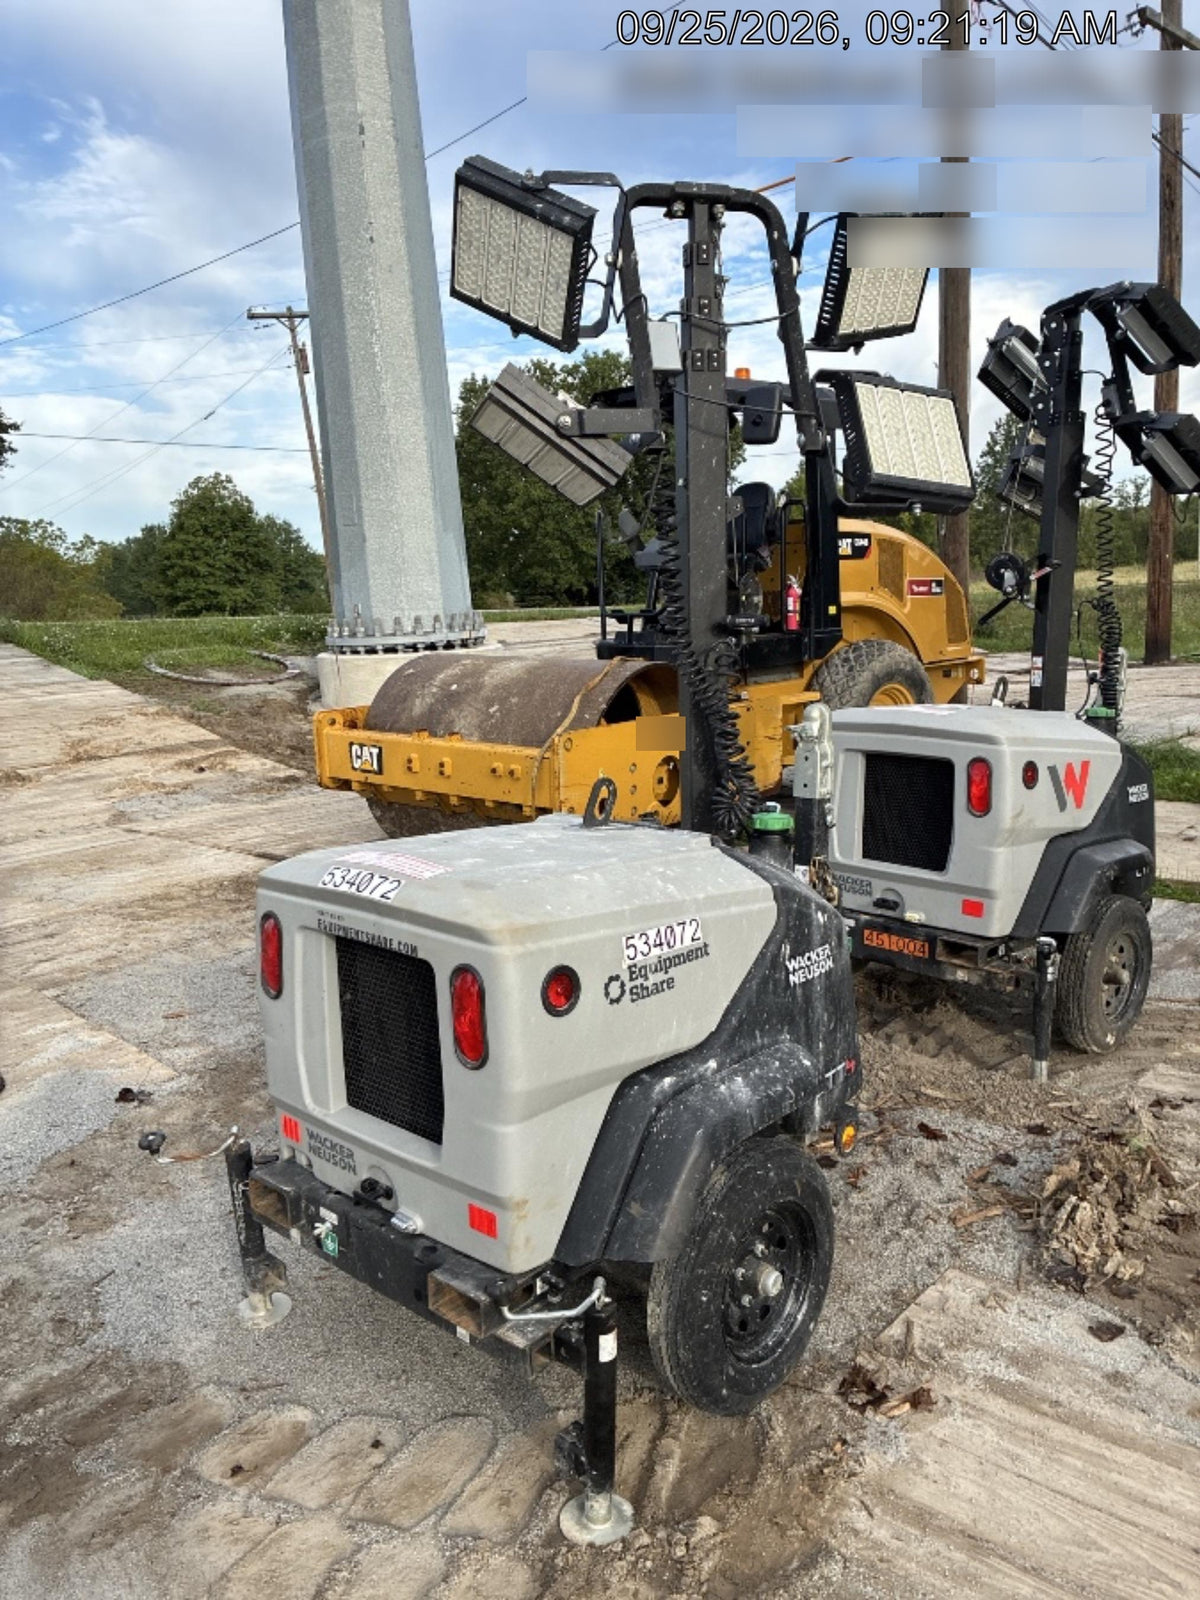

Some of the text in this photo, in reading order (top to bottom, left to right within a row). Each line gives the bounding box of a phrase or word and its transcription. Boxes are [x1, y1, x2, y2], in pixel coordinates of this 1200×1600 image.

[351, 744, 380, 771] CAT
[321, 866, 401, 900] 534072
[625, 918, 701, 961] 534072
[628, 942, 710, 982] Equipment
[786, 944, 832, 972] WACKER
[789, 956, 834, 987] NEUSON
[629, 976, 675, 1003] Share
[306, 1127, 356, 1163] WACKER
[308, 1141, 358, 1176] NEUSON
